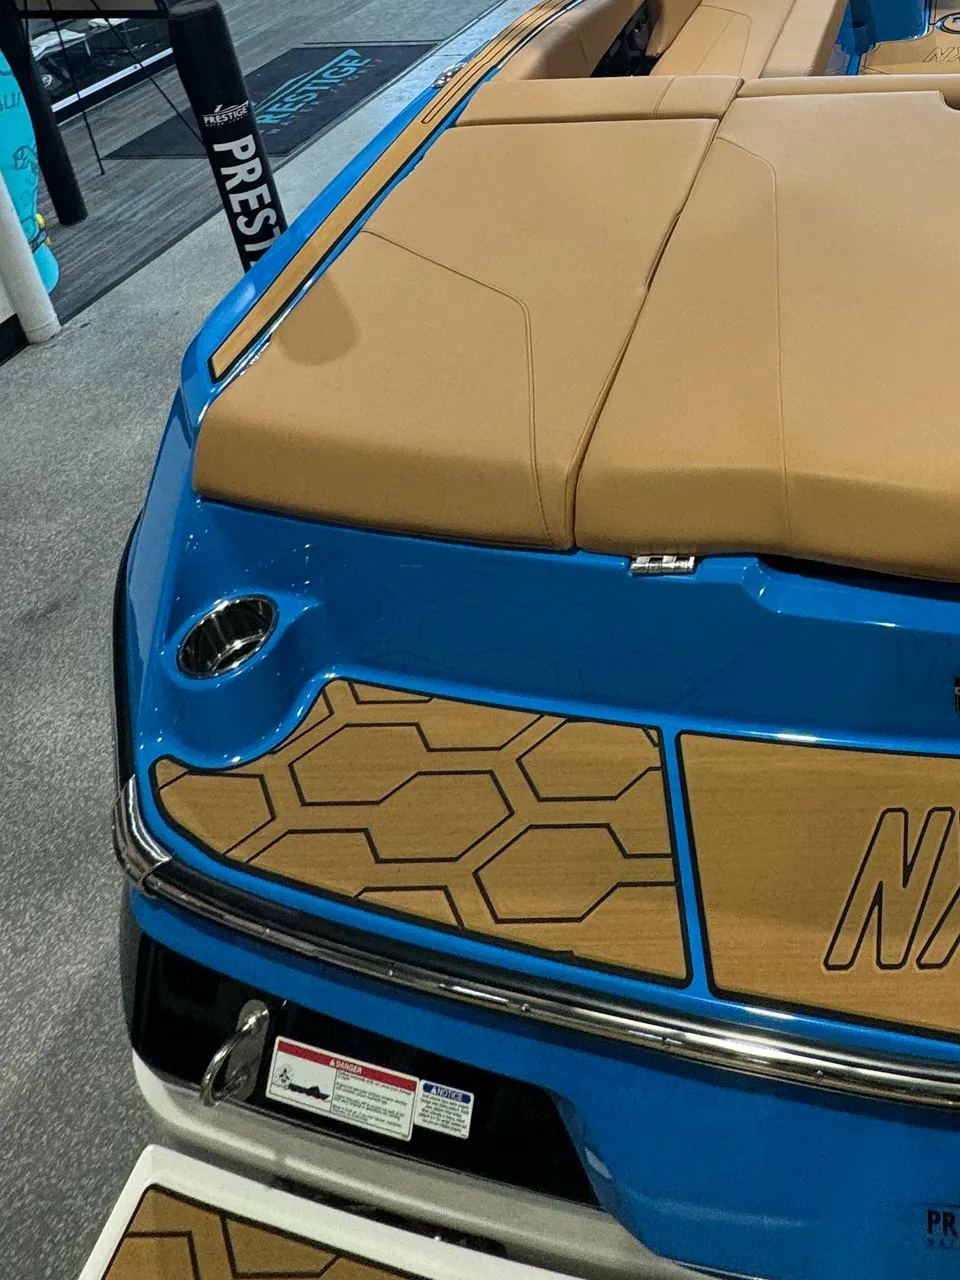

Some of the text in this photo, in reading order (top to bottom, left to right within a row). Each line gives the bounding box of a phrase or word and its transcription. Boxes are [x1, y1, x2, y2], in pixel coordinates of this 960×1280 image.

[256, 58, 372, 124] RESTIGE
[204, 105, 249, 125] PRESTIGE
[213, 134, 281, 269] PREST
[336, 1060, 363, 1075] DANGER
[436, 1086, 464, 1102] NOTICE
